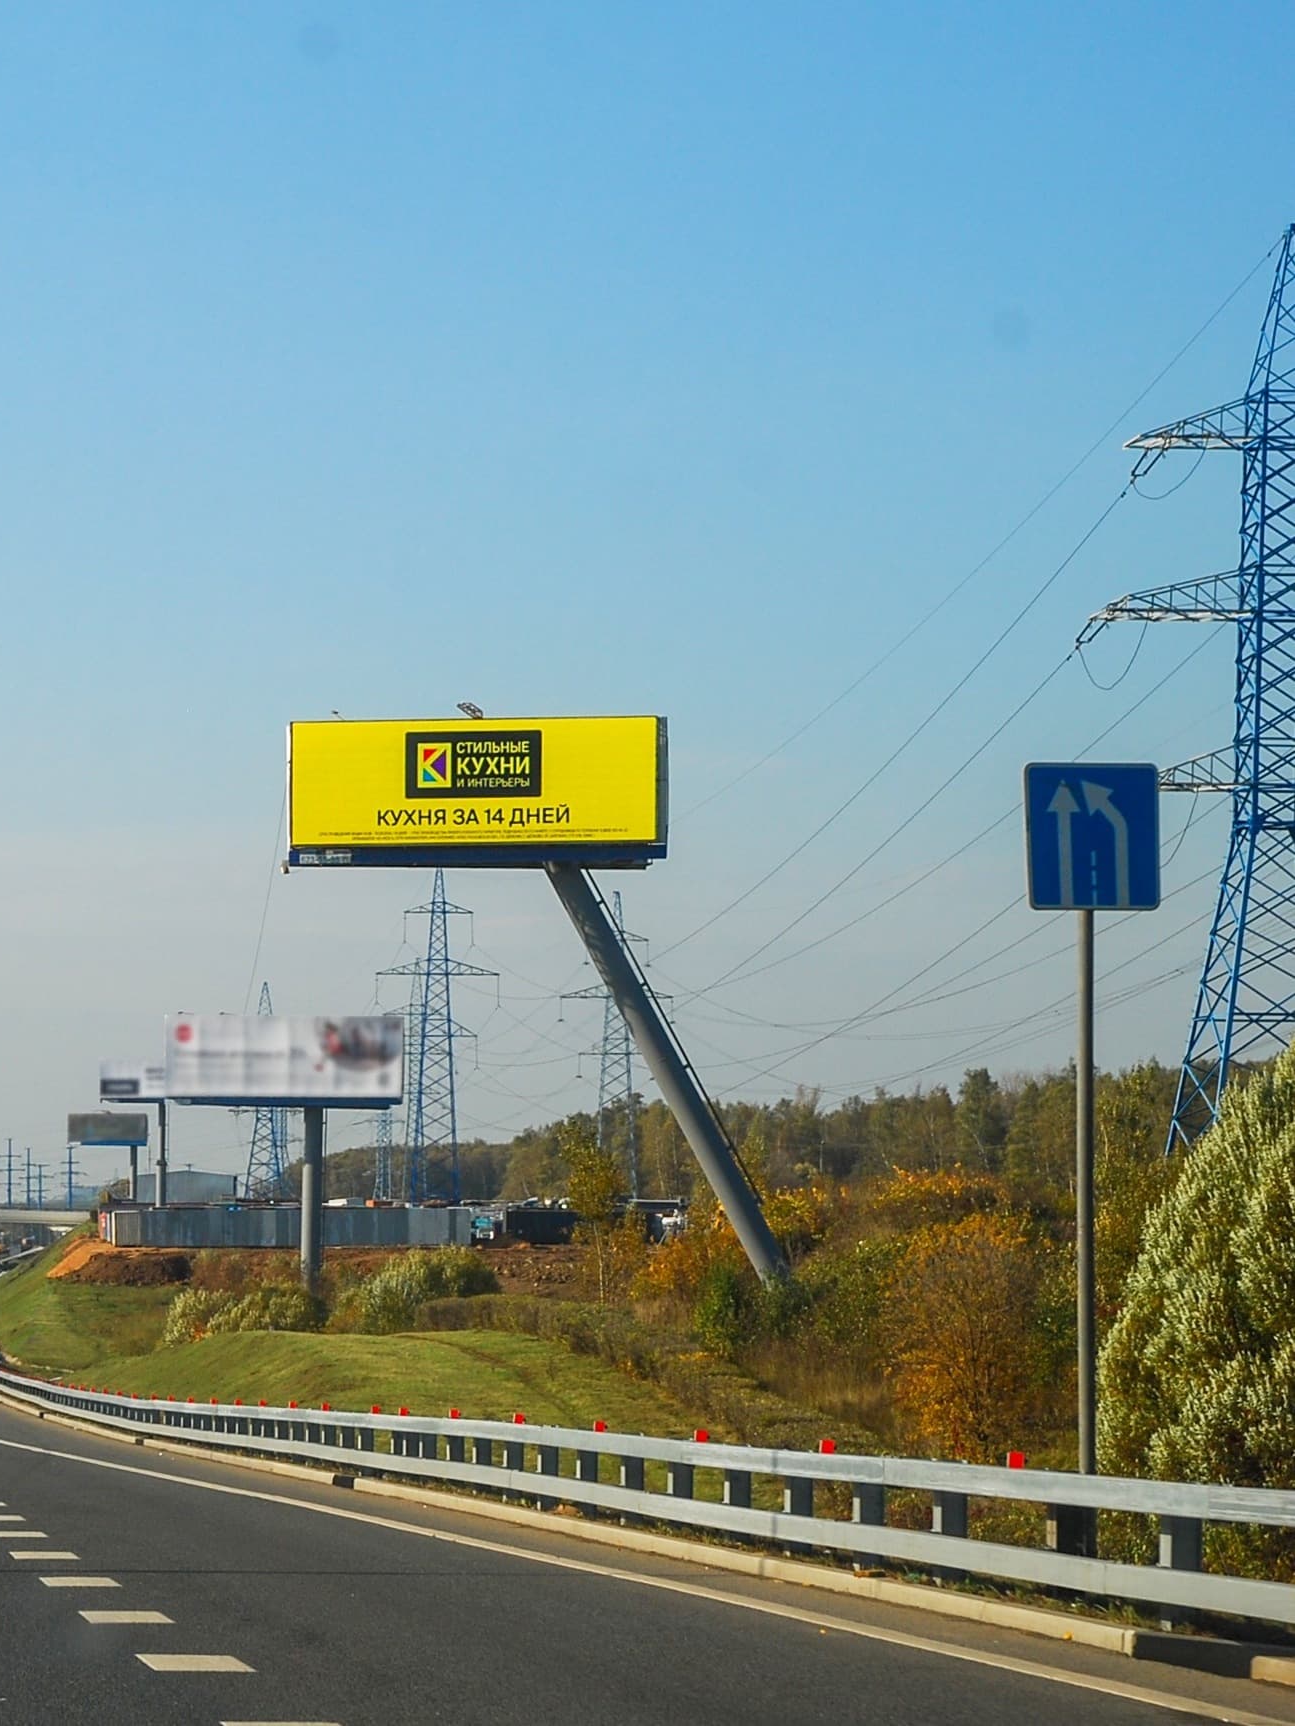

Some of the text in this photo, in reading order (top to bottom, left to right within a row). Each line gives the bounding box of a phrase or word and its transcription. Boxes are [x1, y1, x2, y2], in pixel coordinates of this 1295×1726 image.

[456, 740, 530, 754] СТИЛЬНЫЕ
[456, 756, 530, 775] КУХНИ
[456, 776, 531, 788] И ИНТЕРЬЕРЫ
[377, 803, 571, 827] КУХНЯ ЗА 14 ДНЕЙ
